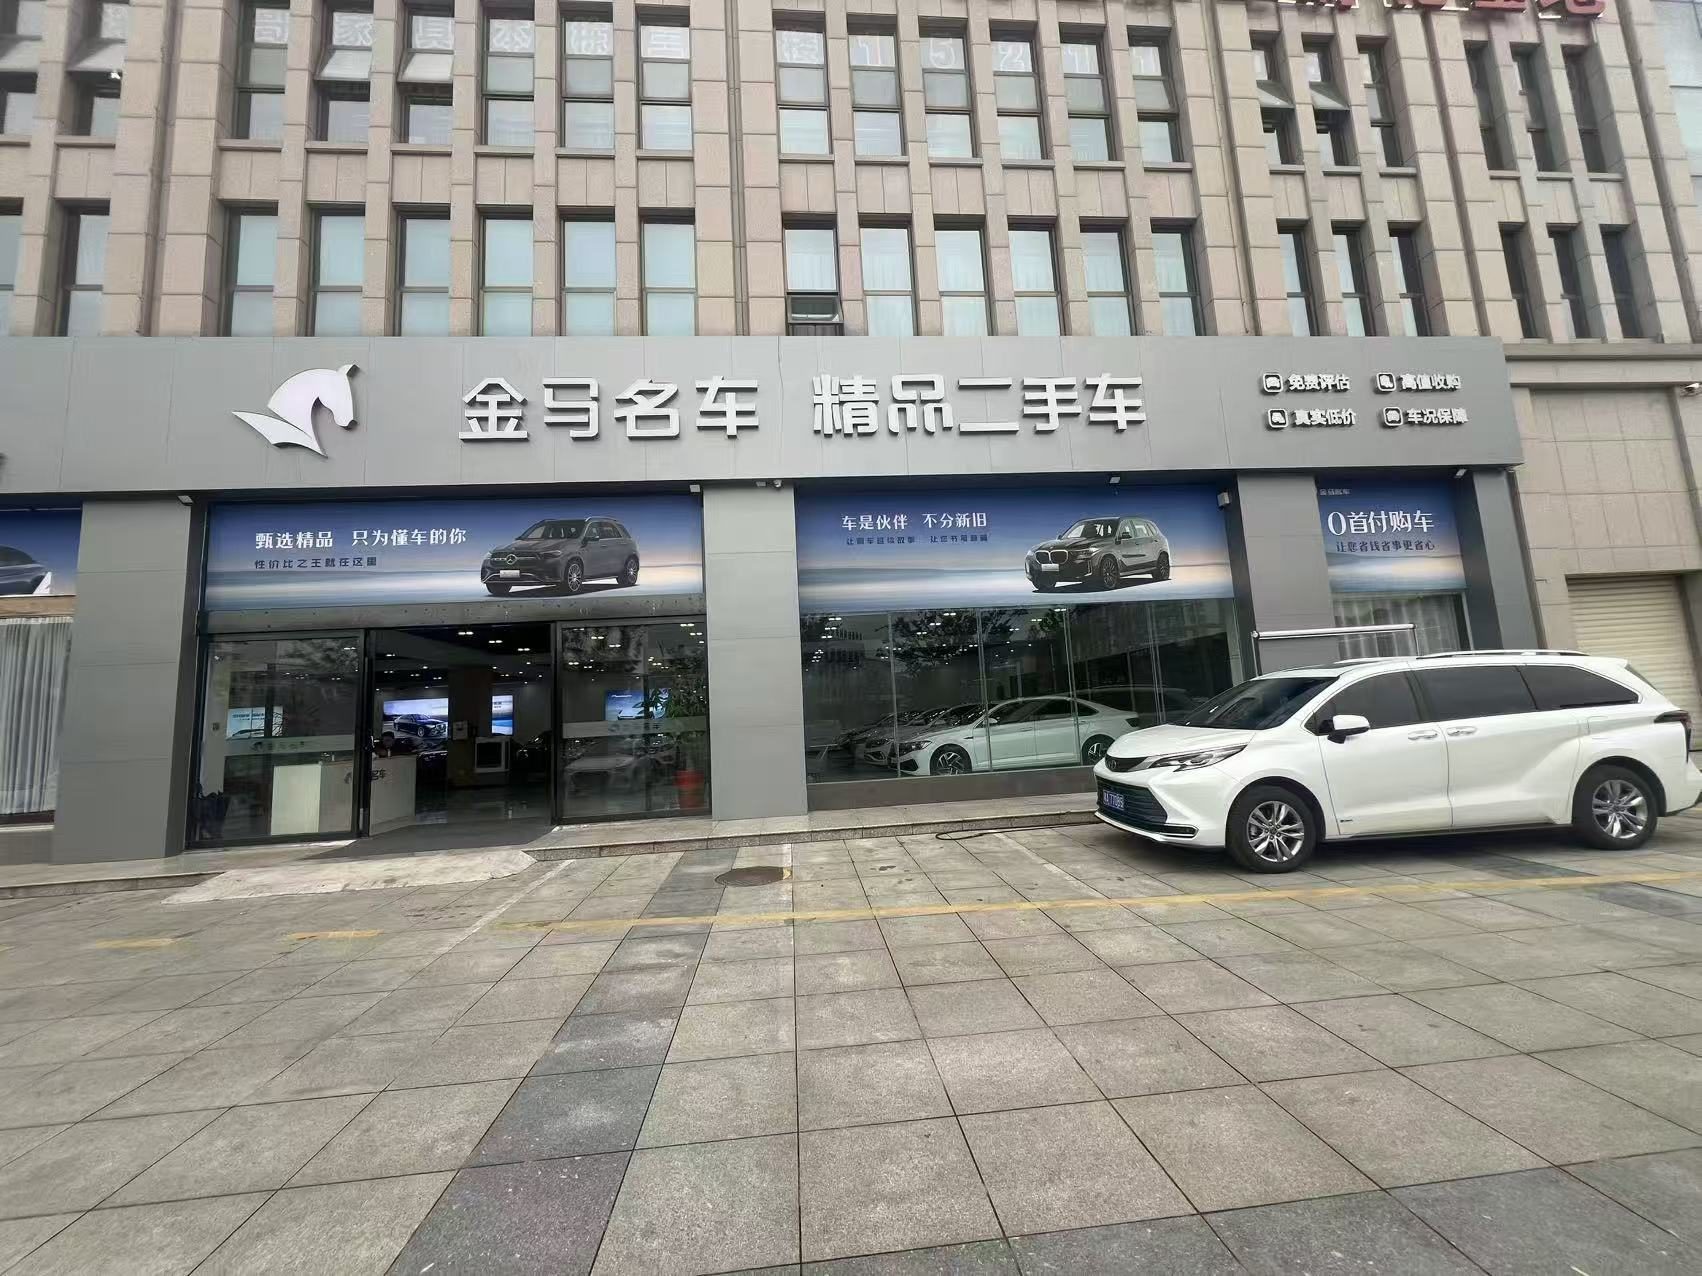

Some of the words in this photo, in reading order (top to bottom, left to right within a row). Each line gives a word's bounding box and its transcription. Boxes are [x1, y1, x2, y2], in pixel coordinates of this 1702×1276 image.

[1287, 374, 1350, 390] 免费评估
[1400, 374, 1461, 390] 高值收购
[459, 376, 759, 440] 金马名车
[812, 373, 1146, 437] 精品二手车
[1294, 408, 1357, 425] 真实低价
[1407, 408, 1469, 424] 车况保障
[841, 514, 908, 531] 车是伙伴
[922, 512, 987, 529] 不分新旧
[1327, 510, 1435, 536] 0首付购车
[255, 531, 333, 549] 甄选精品
[352, 528, 467, 547] 只为懂车的你
[1336, 540, 1436, 552] 让您省钱省事更省心
[254, 556, 377, 570] 性价比之王就在这里
